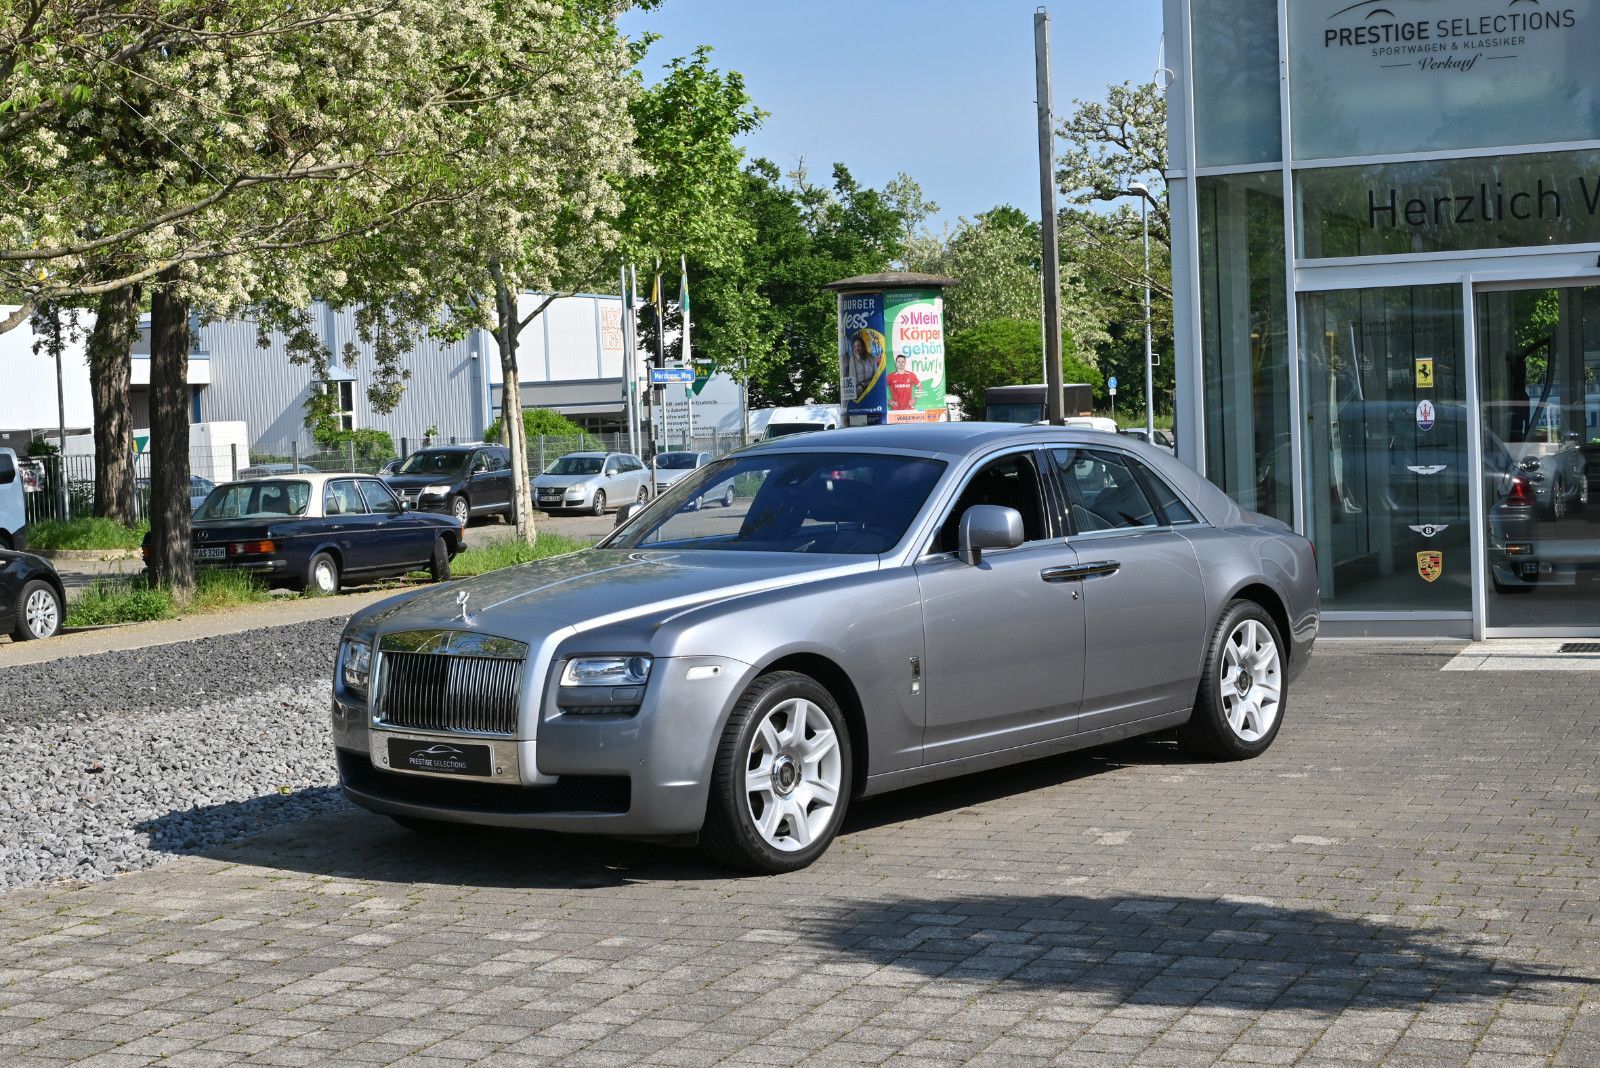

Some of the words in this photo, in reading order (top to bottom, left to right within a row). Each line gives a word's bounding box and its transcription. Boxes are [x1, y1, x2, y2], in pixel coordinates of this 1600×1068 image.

[1324, 21, 1430, 48] PRESTIGE
[1436, 9, 1576, 38] SELECTIONS
[1371, 43, 1447, 57] SPORTWAGEN
[1451, 41, 1458, 51] &
[1463, 36, 1526, 50] KLASSIKER
[1418, 53, 1483, 72] Verkauf
[1368, 178, 1561, 229] Herzlich
